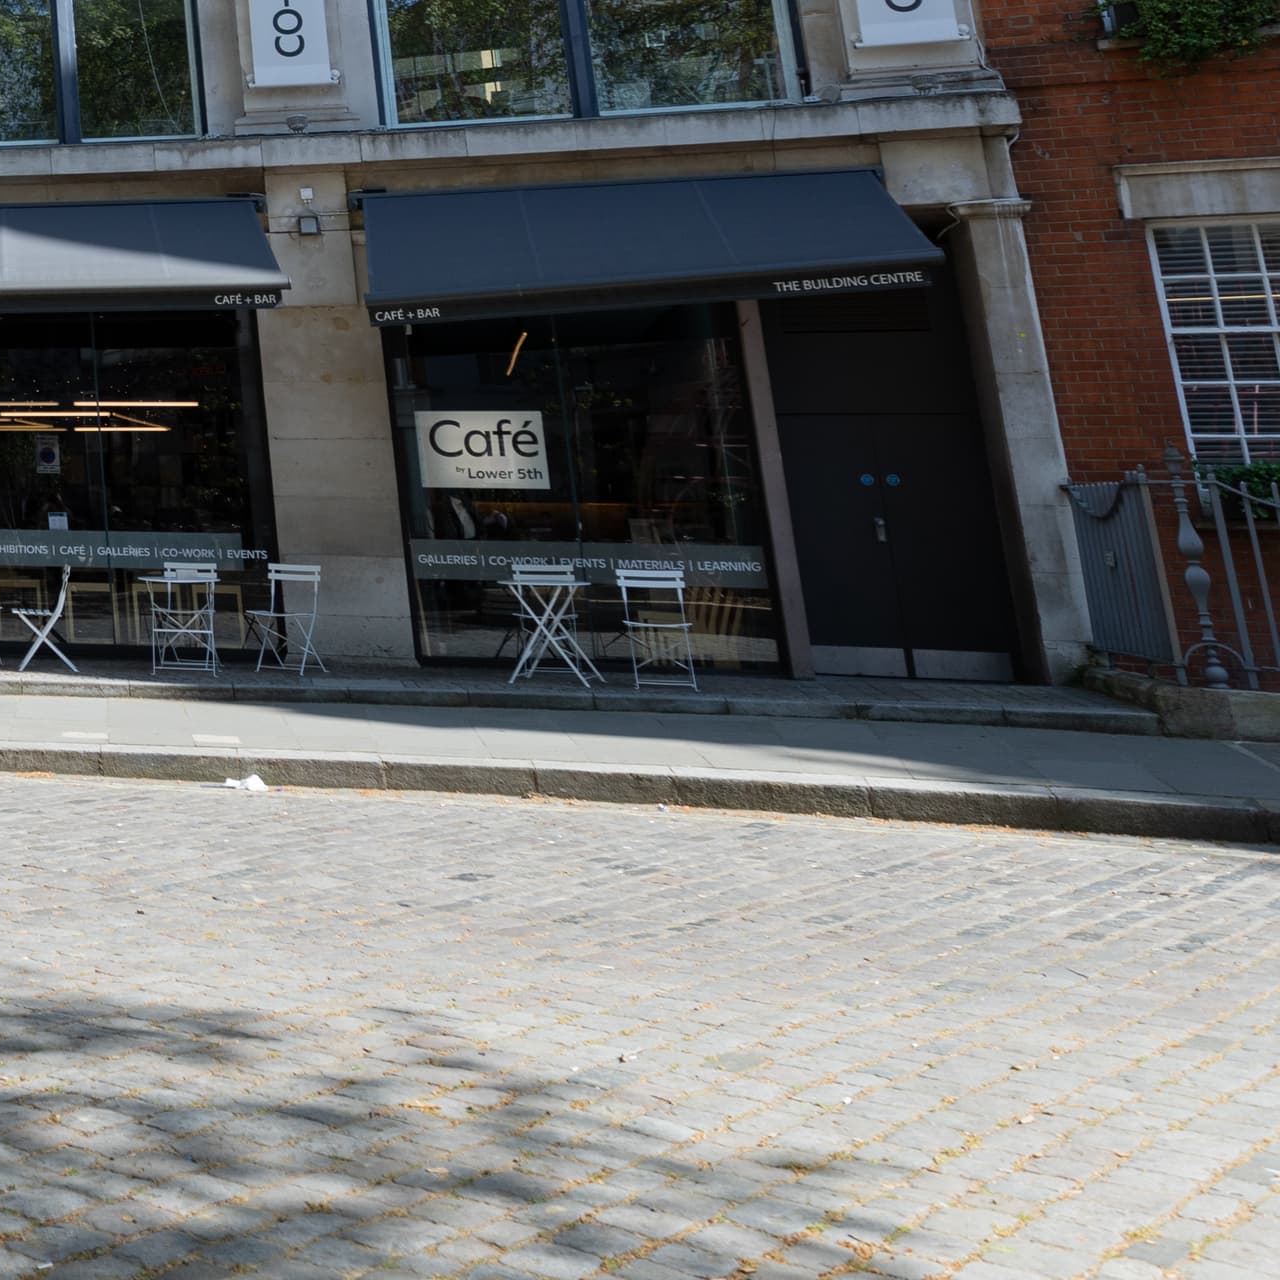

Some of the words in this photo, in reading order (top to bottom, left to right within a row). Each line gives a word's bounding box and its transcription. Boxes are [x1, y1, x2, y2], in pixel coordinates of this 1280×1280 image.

[773, 281, 801, 293] THE
[803, 275, 868, 290] BUILDING
[870, 271, 924, 285] CENTRE
[215, 294, 242, 305] CAFÉ
[255, 294, 276, 304] BAR
[375, 310, 404, 322] CAFÉ
[417, 308, 440, 319] BAR
[429, 418, 539, 458] Café
[455, 466, 465, 474] by
[468, 467, 514, 480] Lower
[517, 468, 543, 480] 5th
[59, 544, 86, 556] CAFÉ
[97, 546, 151, 557] GALLERIES
[162, 547, 215, 558] CO-WORK
[227, 549, 268, 560] EVENTS
[418, 554, 478, 566] GALLERIES
[489, 556, 548, 567] CO-WORK
[559, 557, 606, 569] EVENTS
[618, 559, 685, 570] MATERIALS
[697, 561, 762, 572] LEARNING
